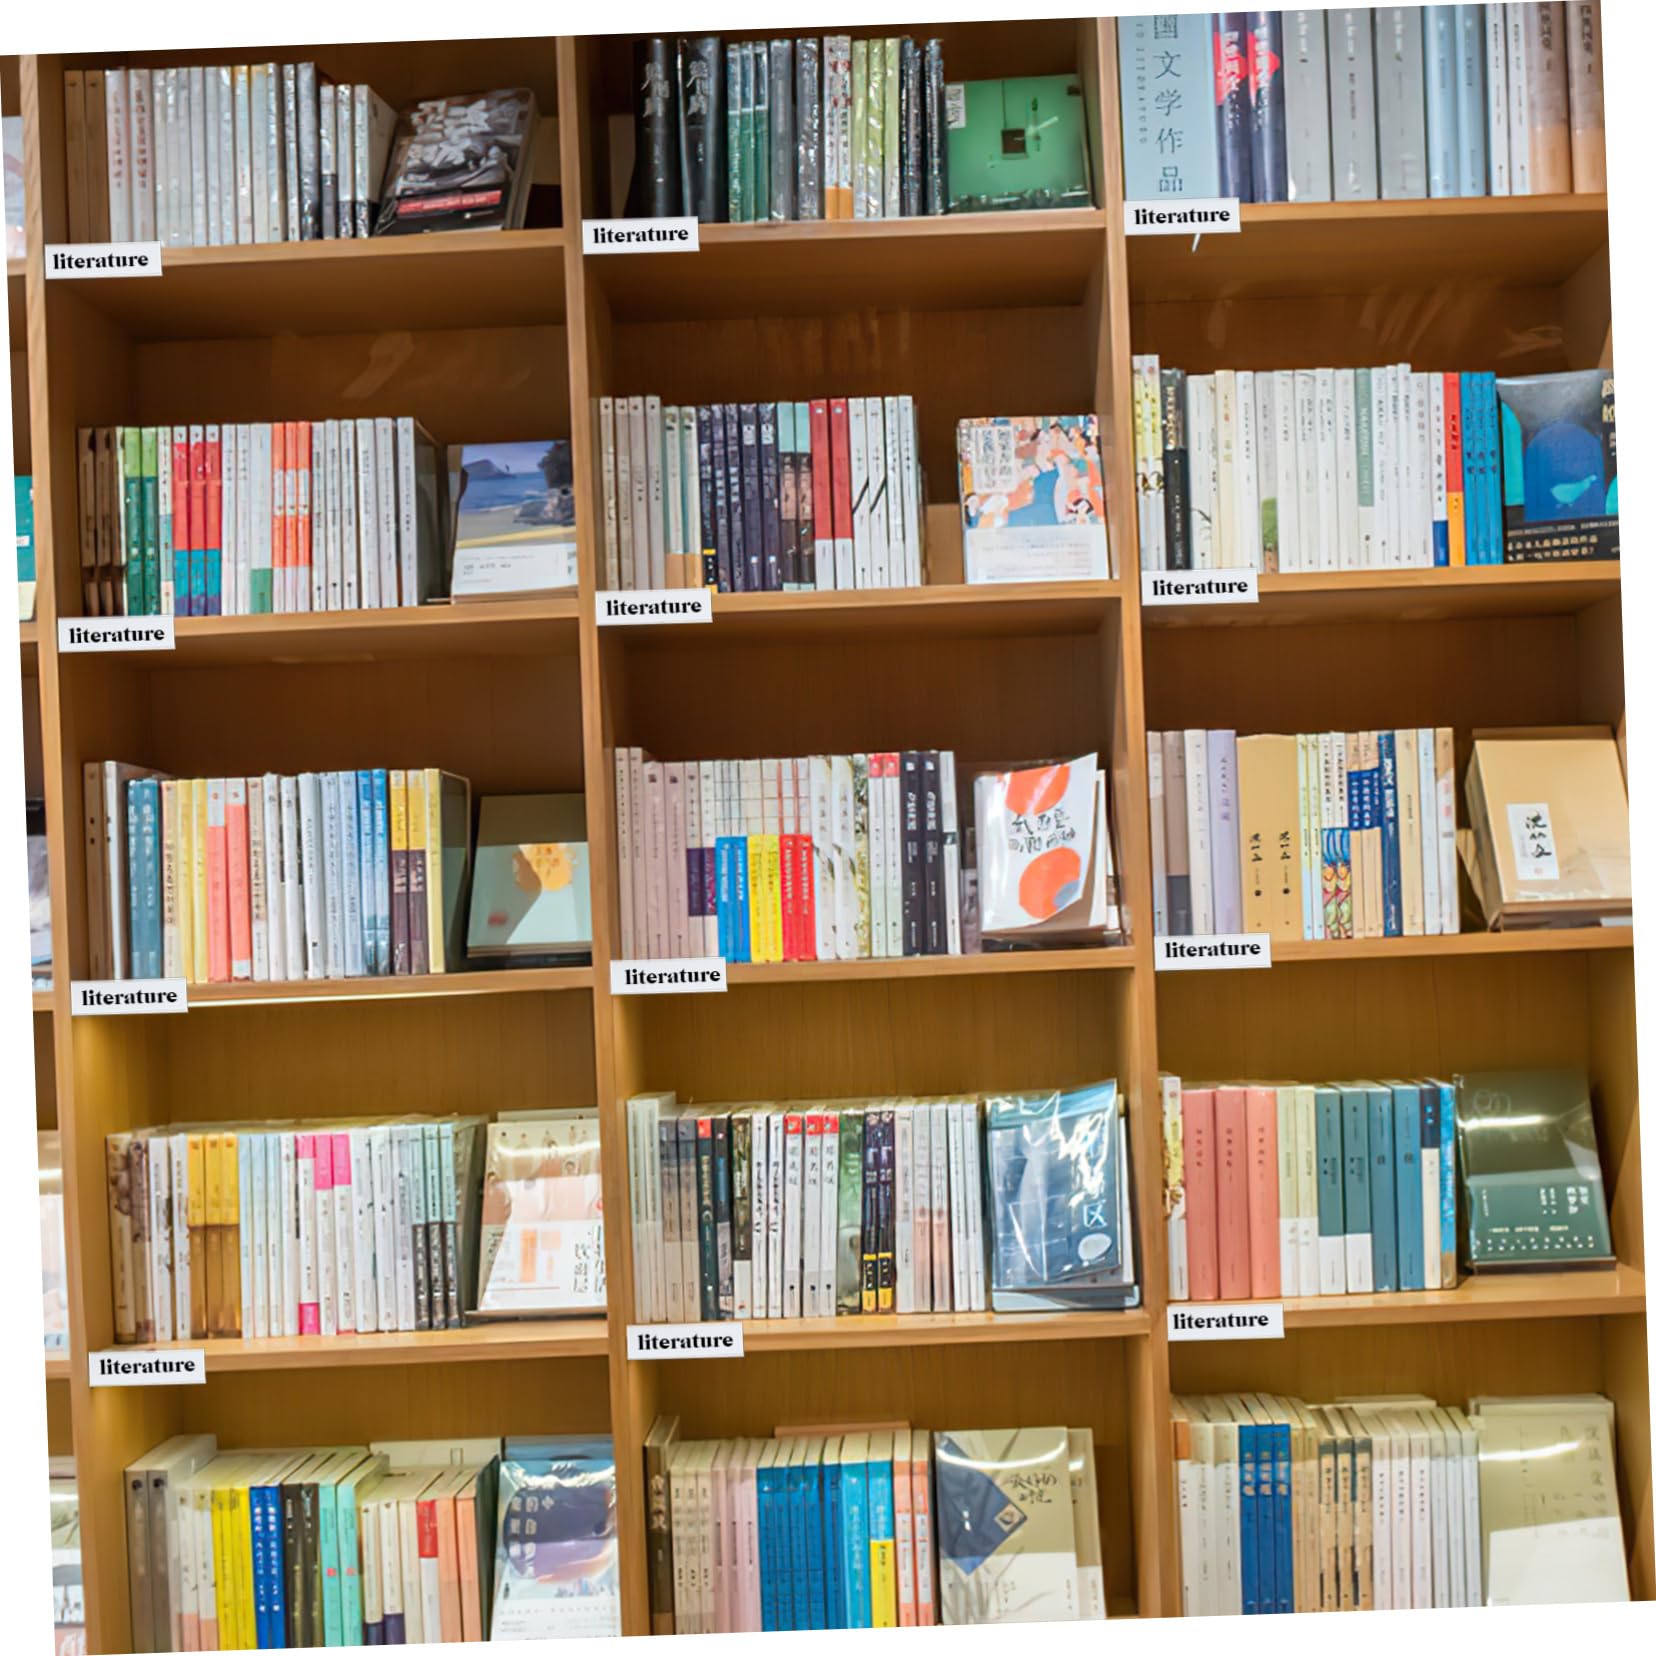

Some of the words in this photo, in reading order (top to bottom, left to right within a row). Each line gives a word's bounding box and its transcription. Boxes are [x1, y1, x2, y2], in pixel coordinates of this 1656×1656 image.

[1134, 208, 1230, 225] literature
[593, 227, 689, 244] literature
[53, 253, 149, 270] literature
[1152, 579, 1248, 596] literature
[606, 599, 702, 616] literature
[69, 627, 165, 644] literature
[1165, 941, 1261, 958] literature
[625, 968, 721, 985] literature
[82, 989, 177, 1006] literature
[1173, 1313, 1269, 1330] literature
[638, 1333, 733, 1351] literature
[100, 1358, 195, 1375] literature
